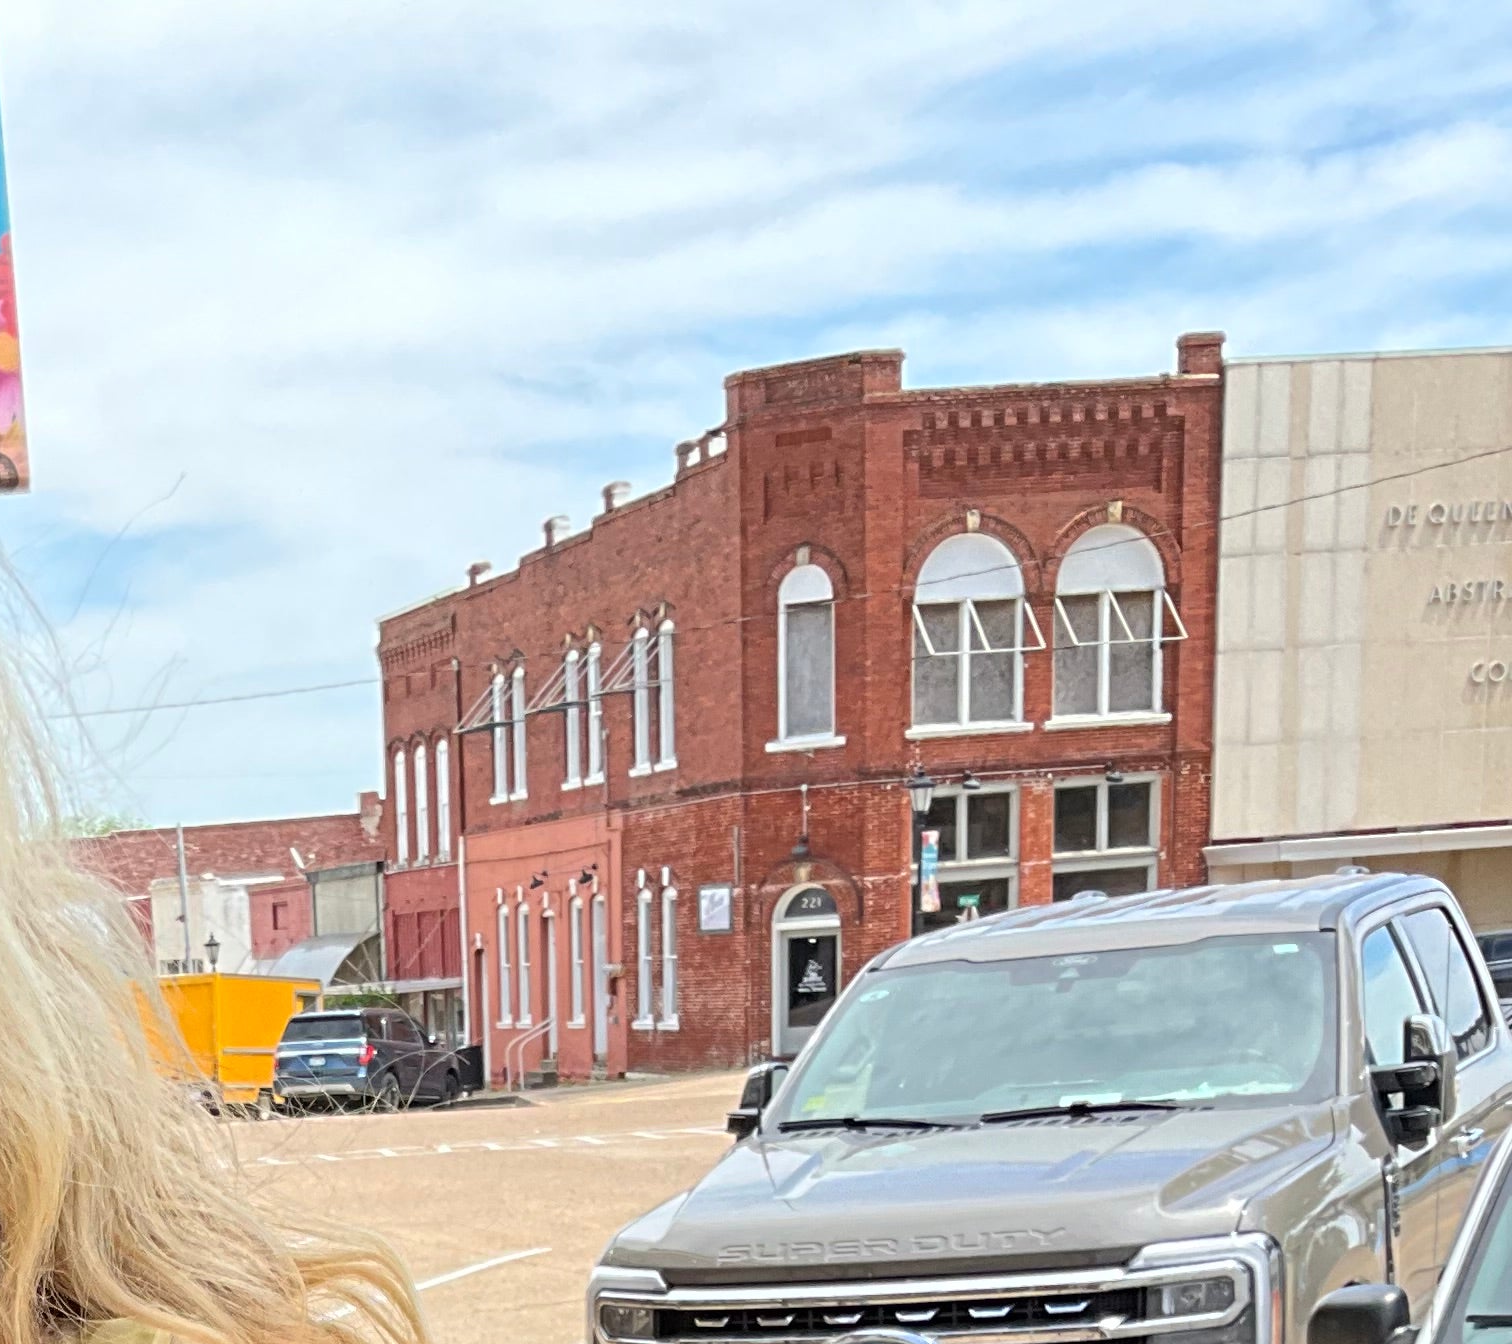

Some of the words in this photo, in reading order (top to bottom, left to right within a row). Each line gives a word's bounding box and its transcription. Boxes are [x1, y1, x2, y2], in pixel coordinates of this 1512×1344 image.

[1388, 504, 1418, 526] DE
[1431, 580, 1512, 602] ABSTR
[1472, 660, 1512, 683] CO
[801, 896, 822, 909] 221
[717, 1238, 899, 1266] SUPER
[909, 1226, 1067, 1252] DUTY
